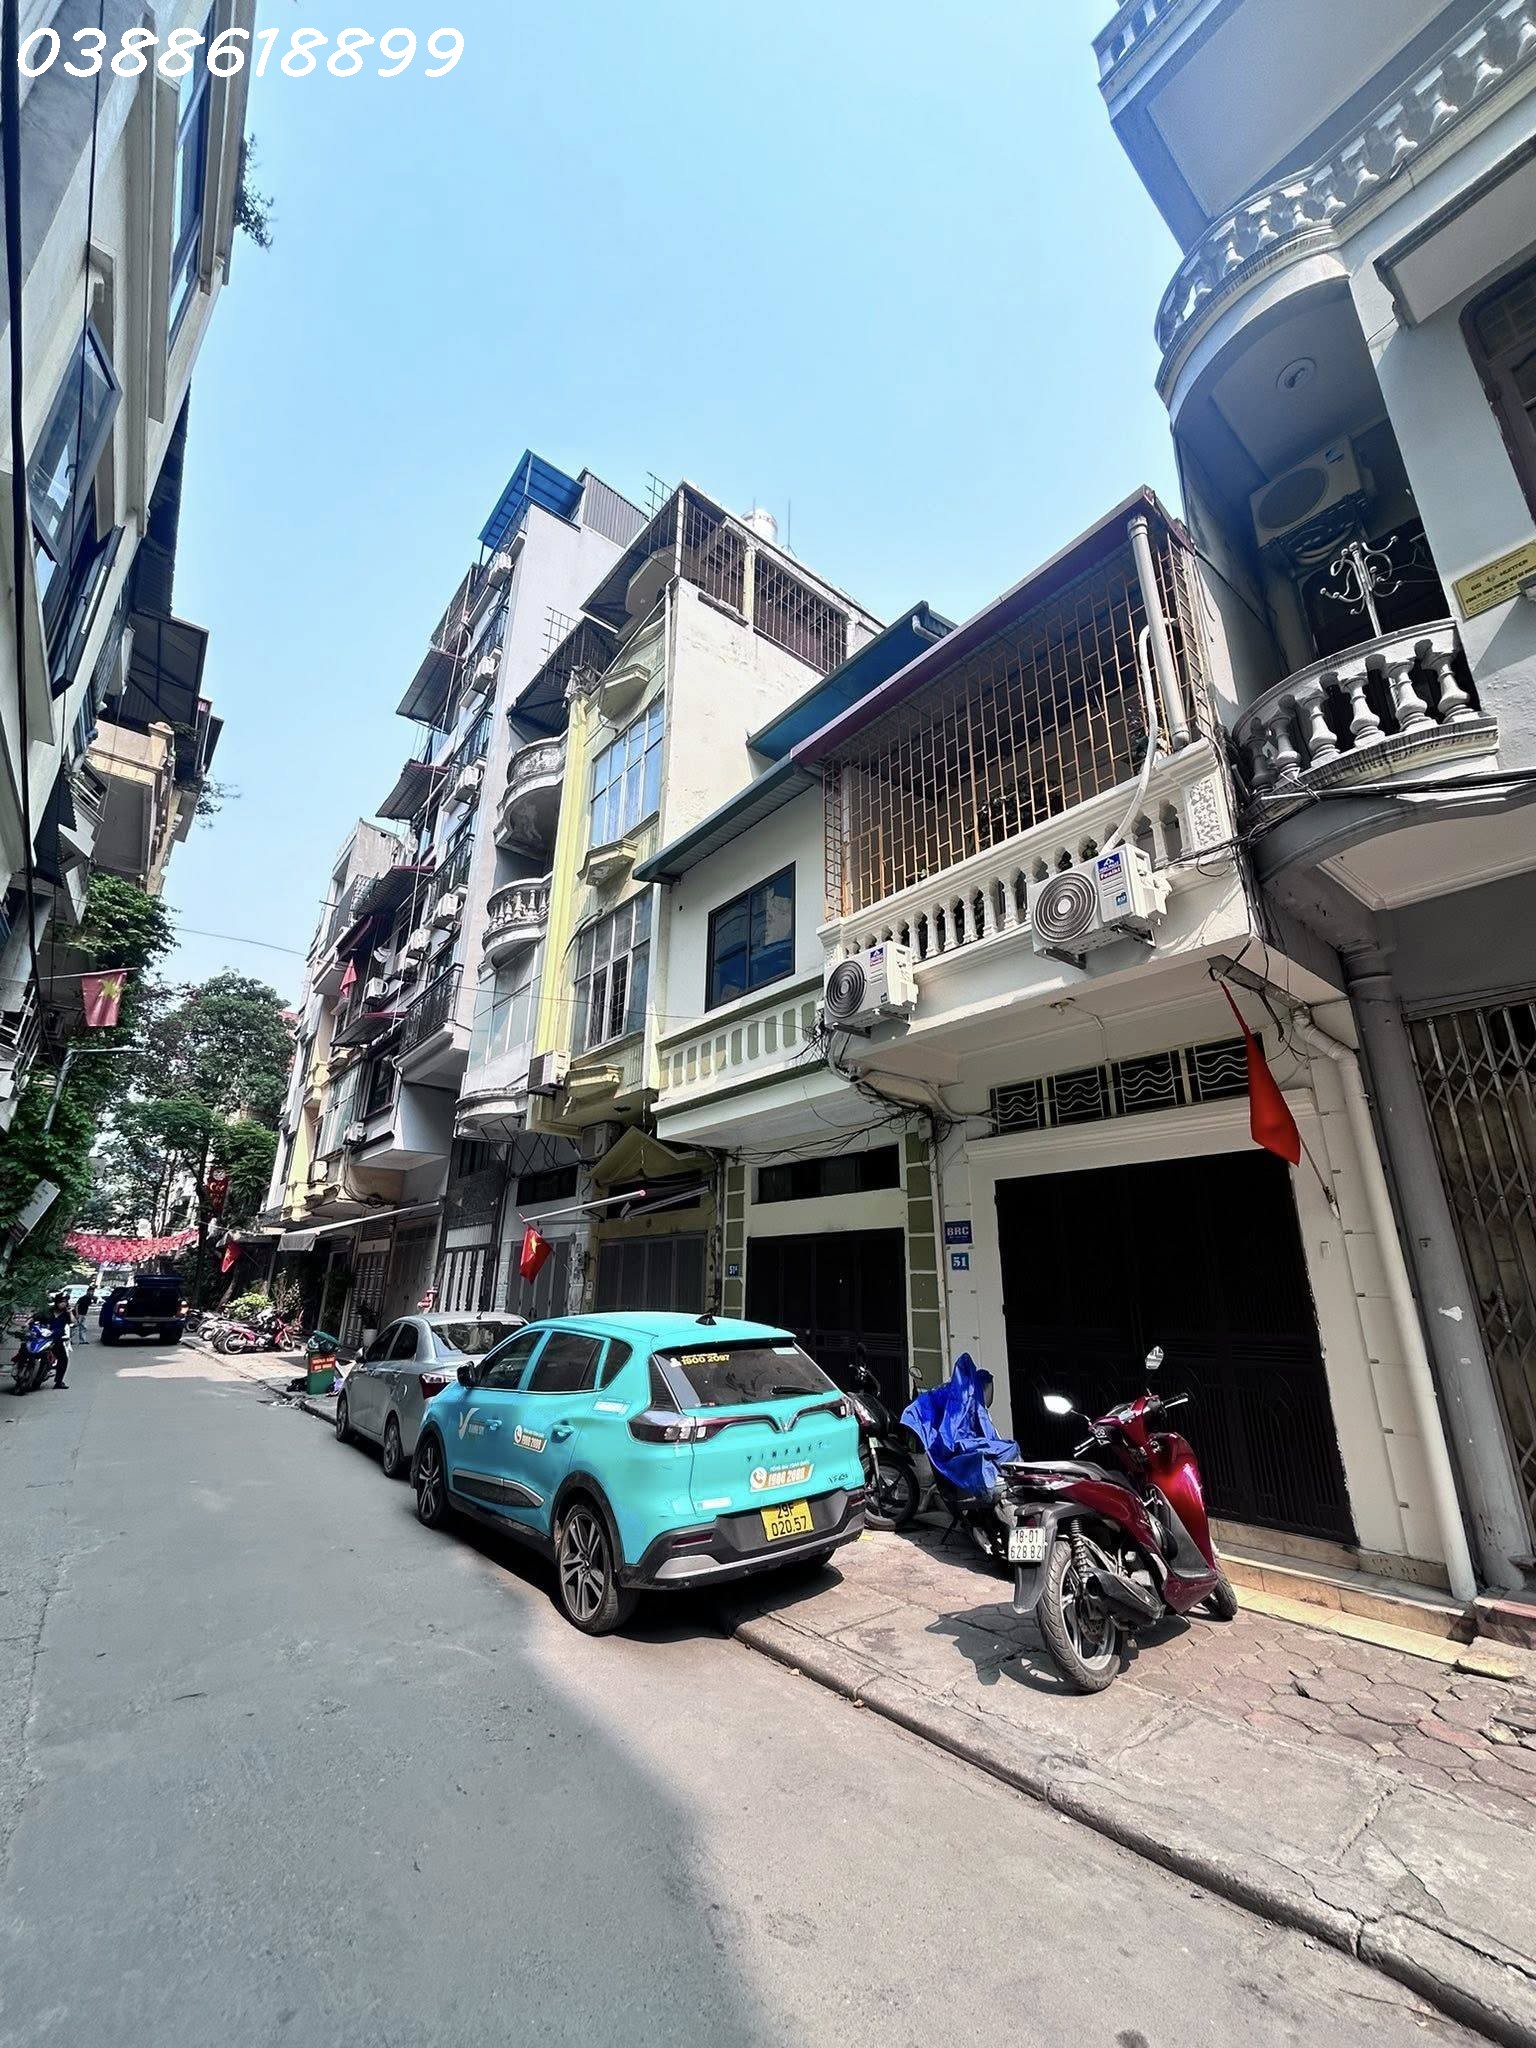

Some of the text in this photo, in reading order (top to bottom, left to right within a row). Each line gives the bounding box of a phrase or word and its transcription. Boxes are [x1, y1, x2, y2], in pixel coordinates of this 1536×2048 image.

[946, 1226, 969, 1236] BRC
[953, 1256, 967, 1267] 51
[771, 1515, 807, 1536] 020.57
